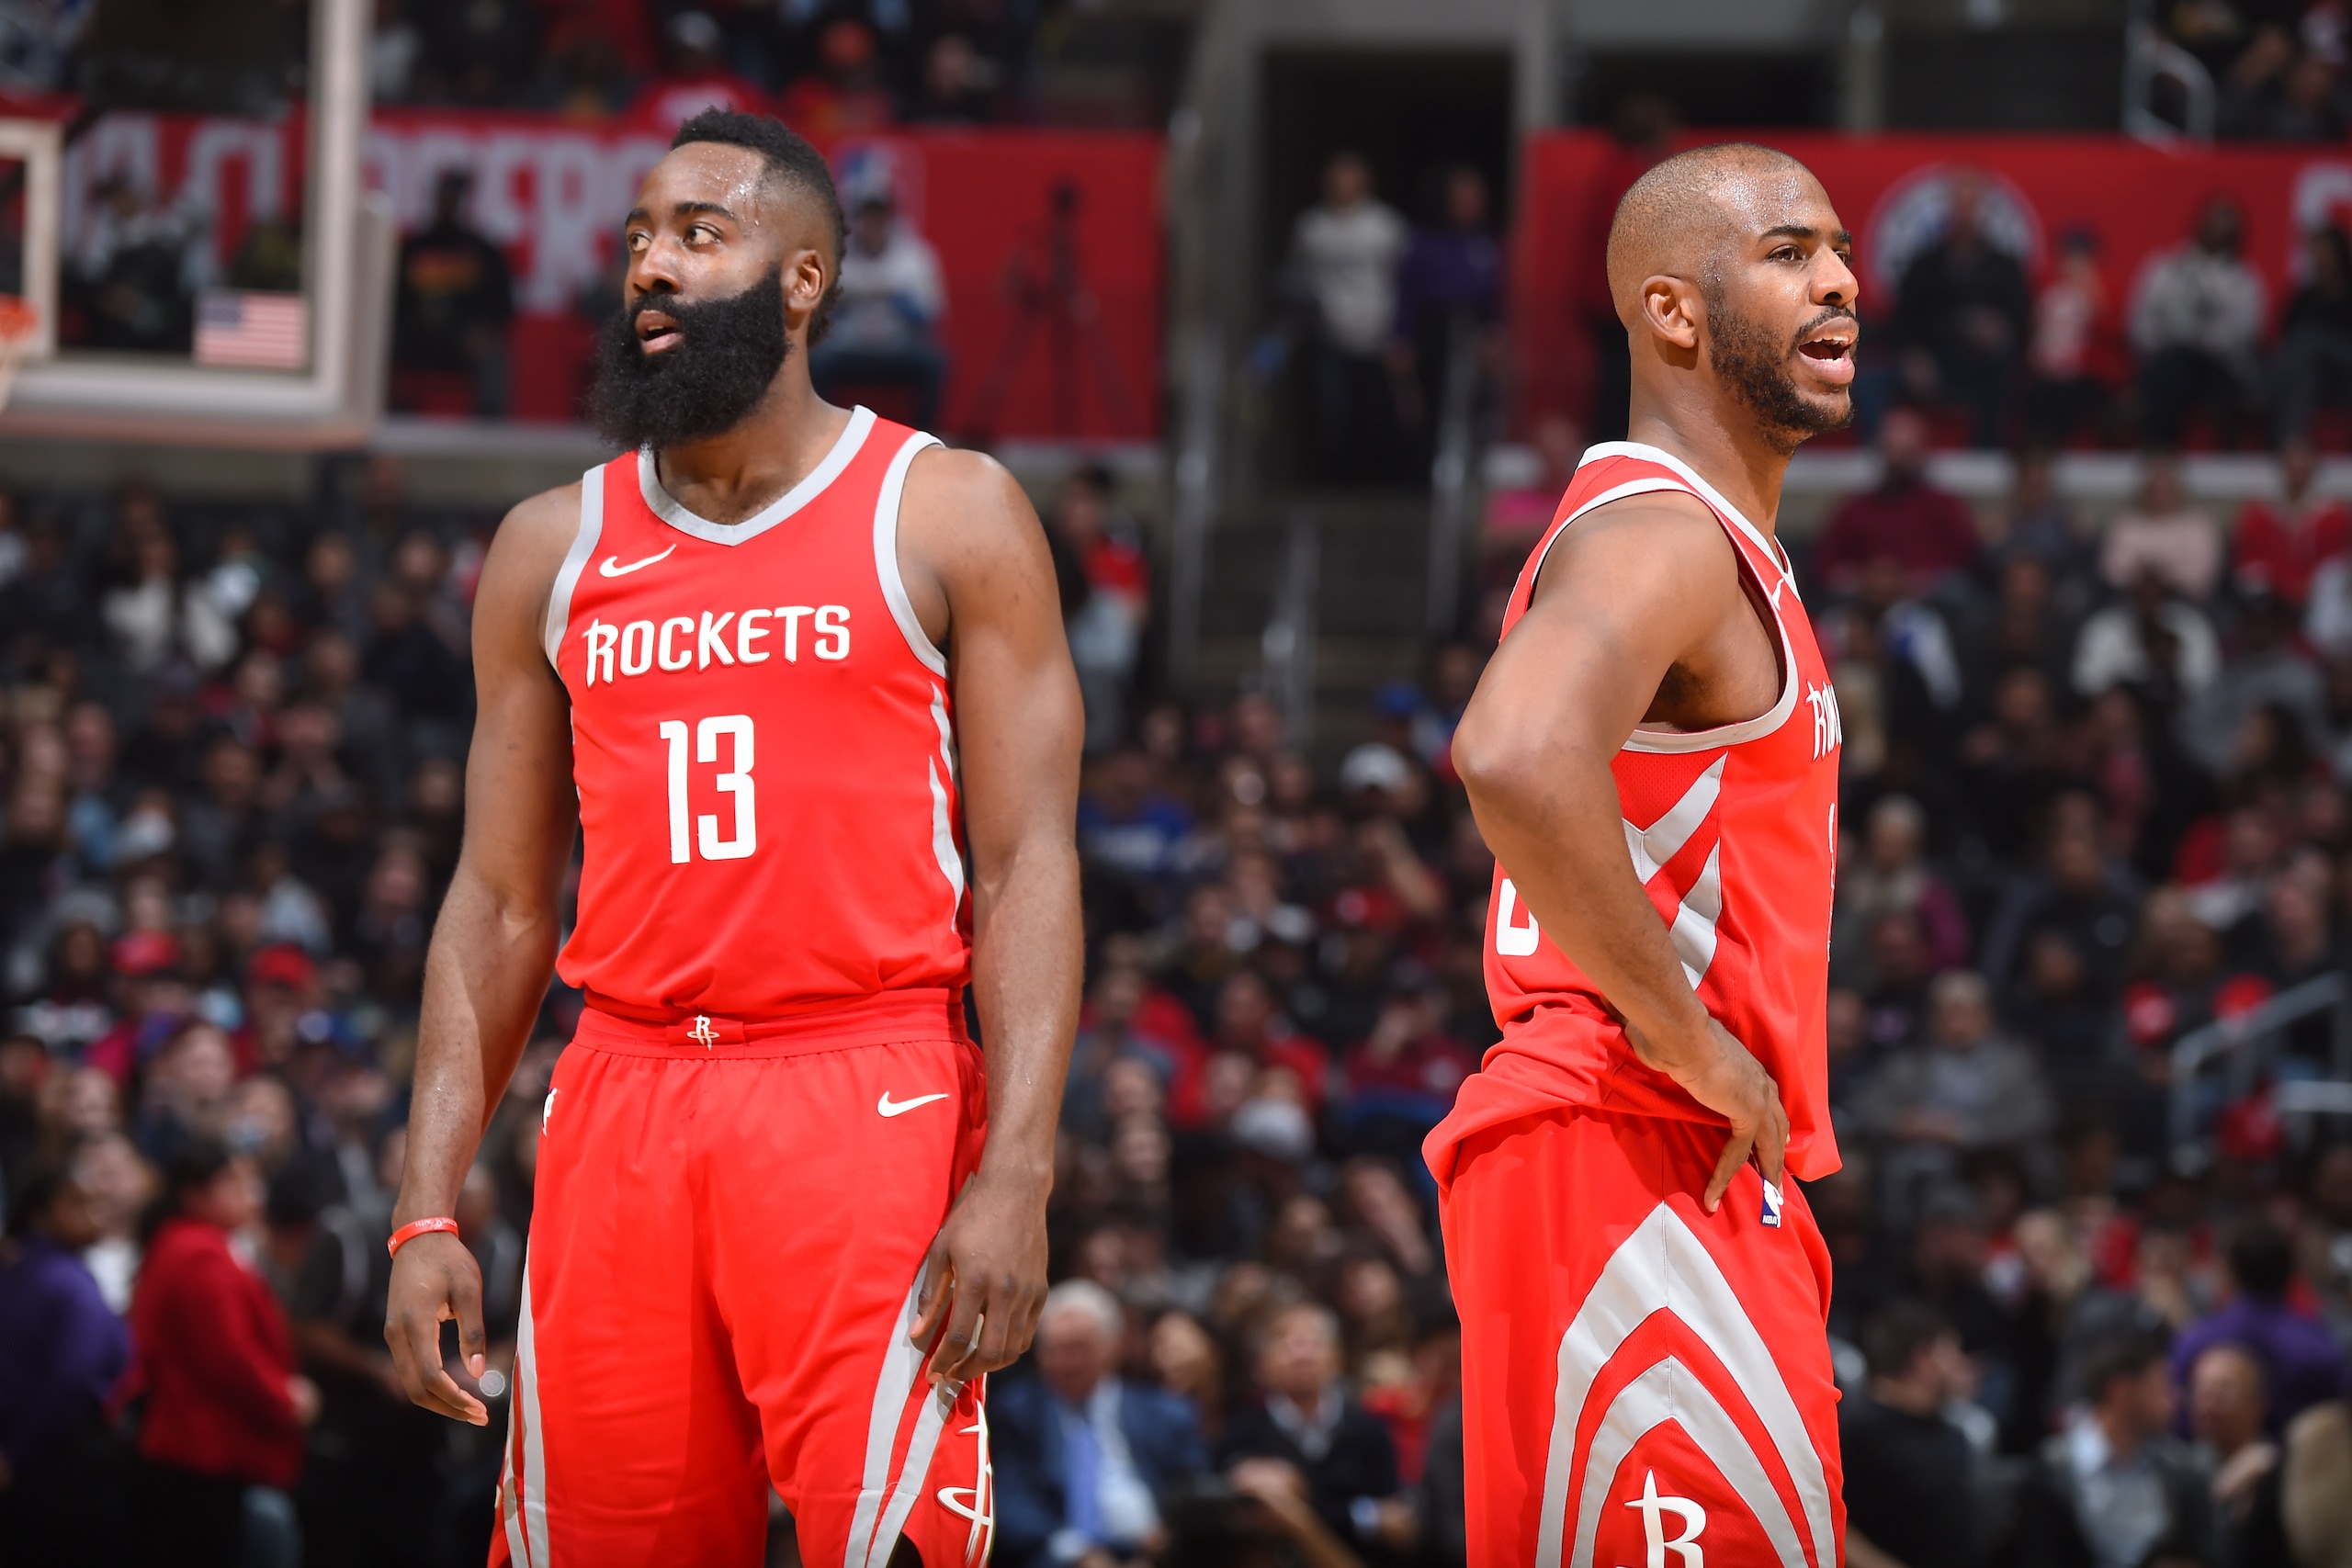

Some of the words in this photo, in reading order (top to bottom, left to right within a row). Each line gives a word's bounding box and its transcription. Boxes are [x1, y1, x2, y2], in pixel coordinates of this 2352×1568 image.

[582, 605, 851, 688] ROCKETS
[659, 715, 756, 863] 13
[1762, 1214, 1778, 1225] NBA
